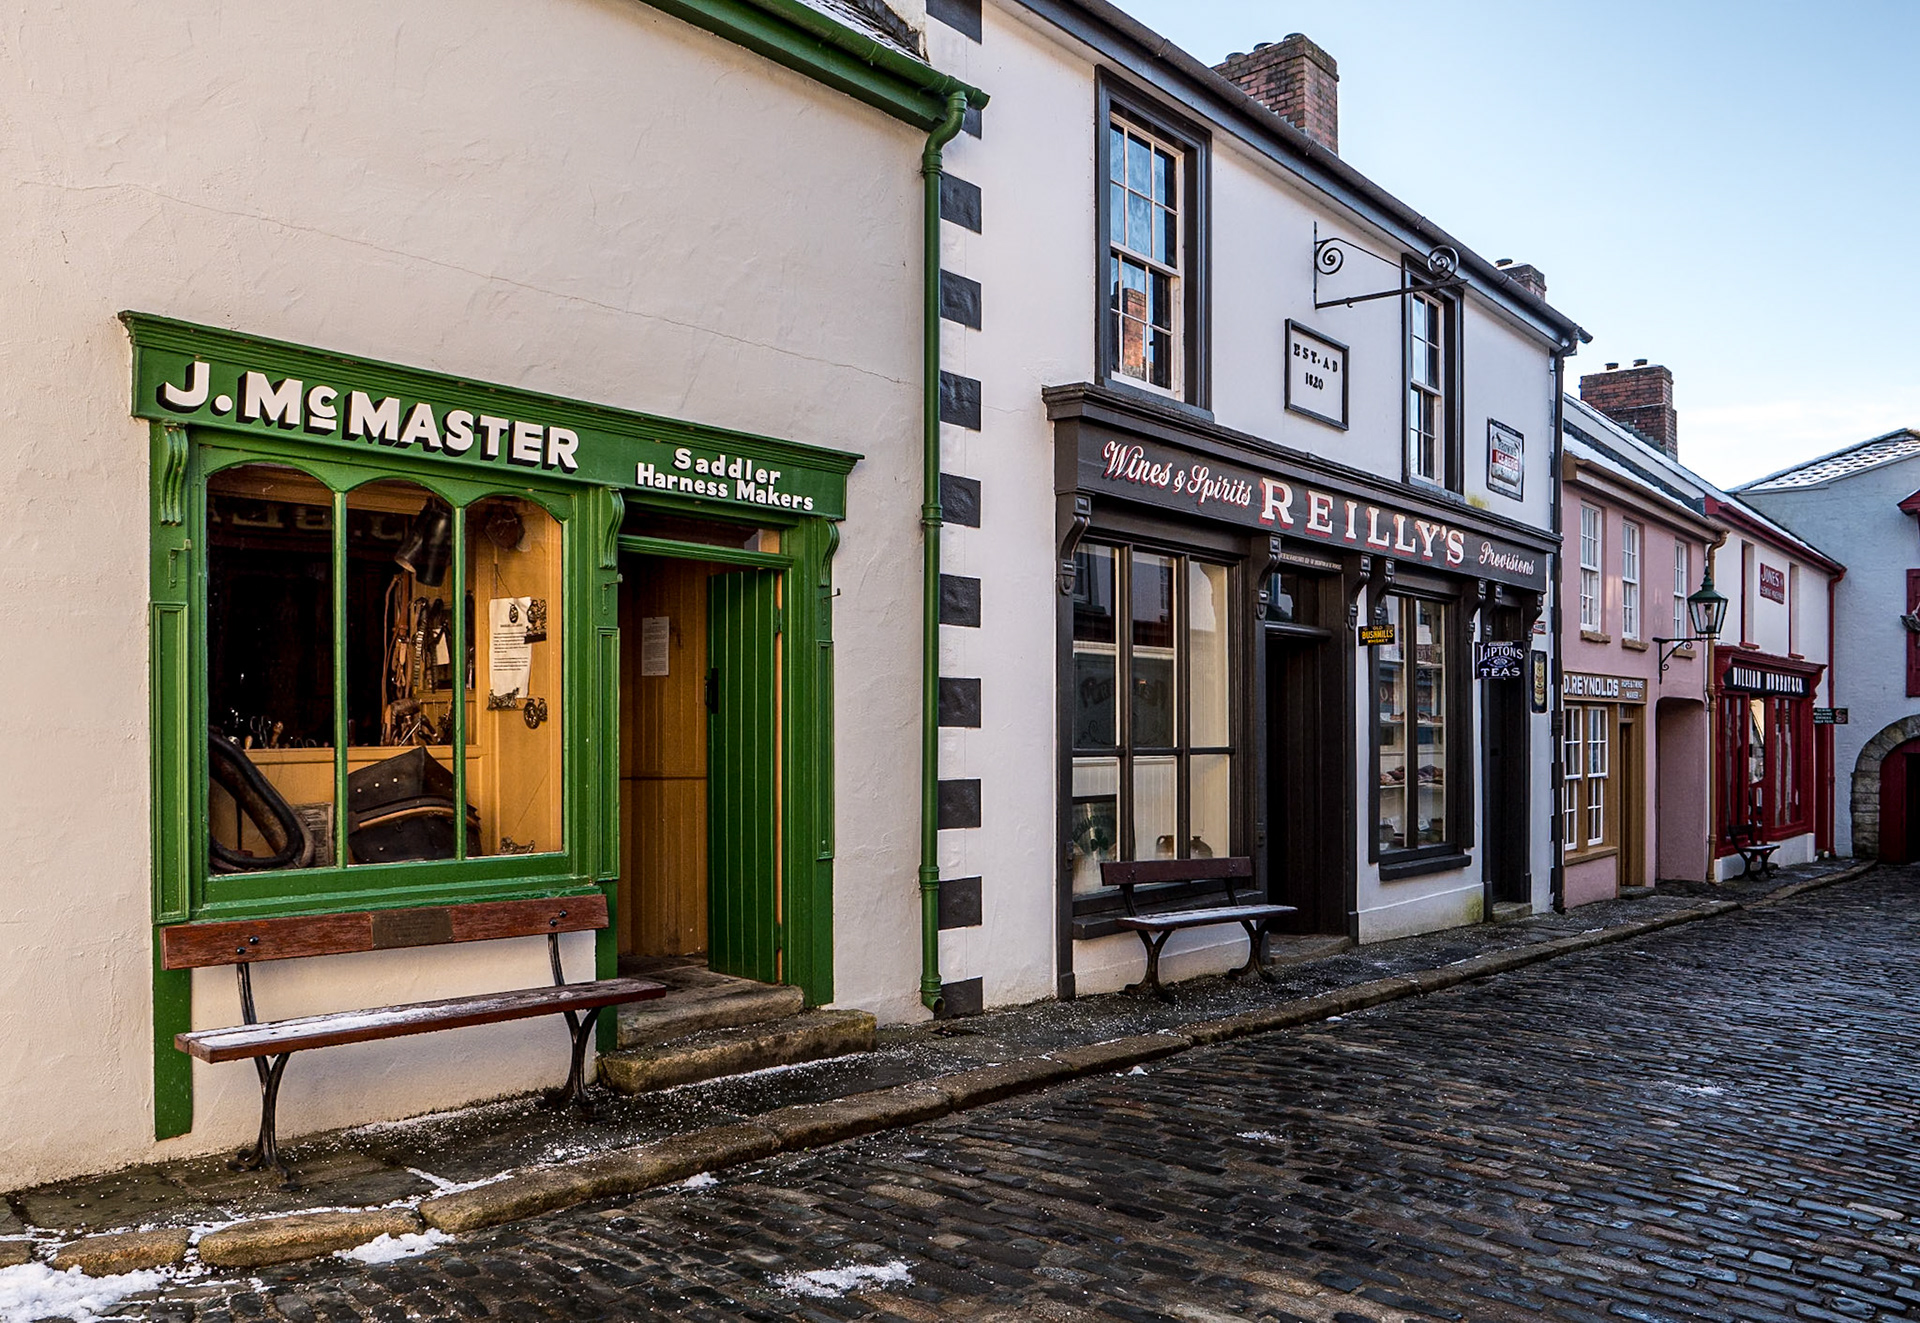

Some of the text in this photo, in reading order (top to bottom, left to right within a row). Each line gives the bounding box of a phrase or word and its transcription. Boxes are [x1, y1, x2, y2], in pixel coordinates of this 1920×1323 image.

[1293, 342, 1320, 364] EST.
[1305, 371, 1324, 390] 1820
[673, 447, 781, 485] Saddler
[636, 462, 814, 511] Harness Makers
[1103, 440, 1173, 487] Wines
[1174, 470, 1186, 493] &
[1187, 464, 1252, 506] Spirits
[1260, 477, 1466, 566] REILLY'S
[1479, 541, 1535, 576] Provisions
[1477, 643, 1524, 664] LIPTONS
[1480, 667, 1521, 677] TEAS
